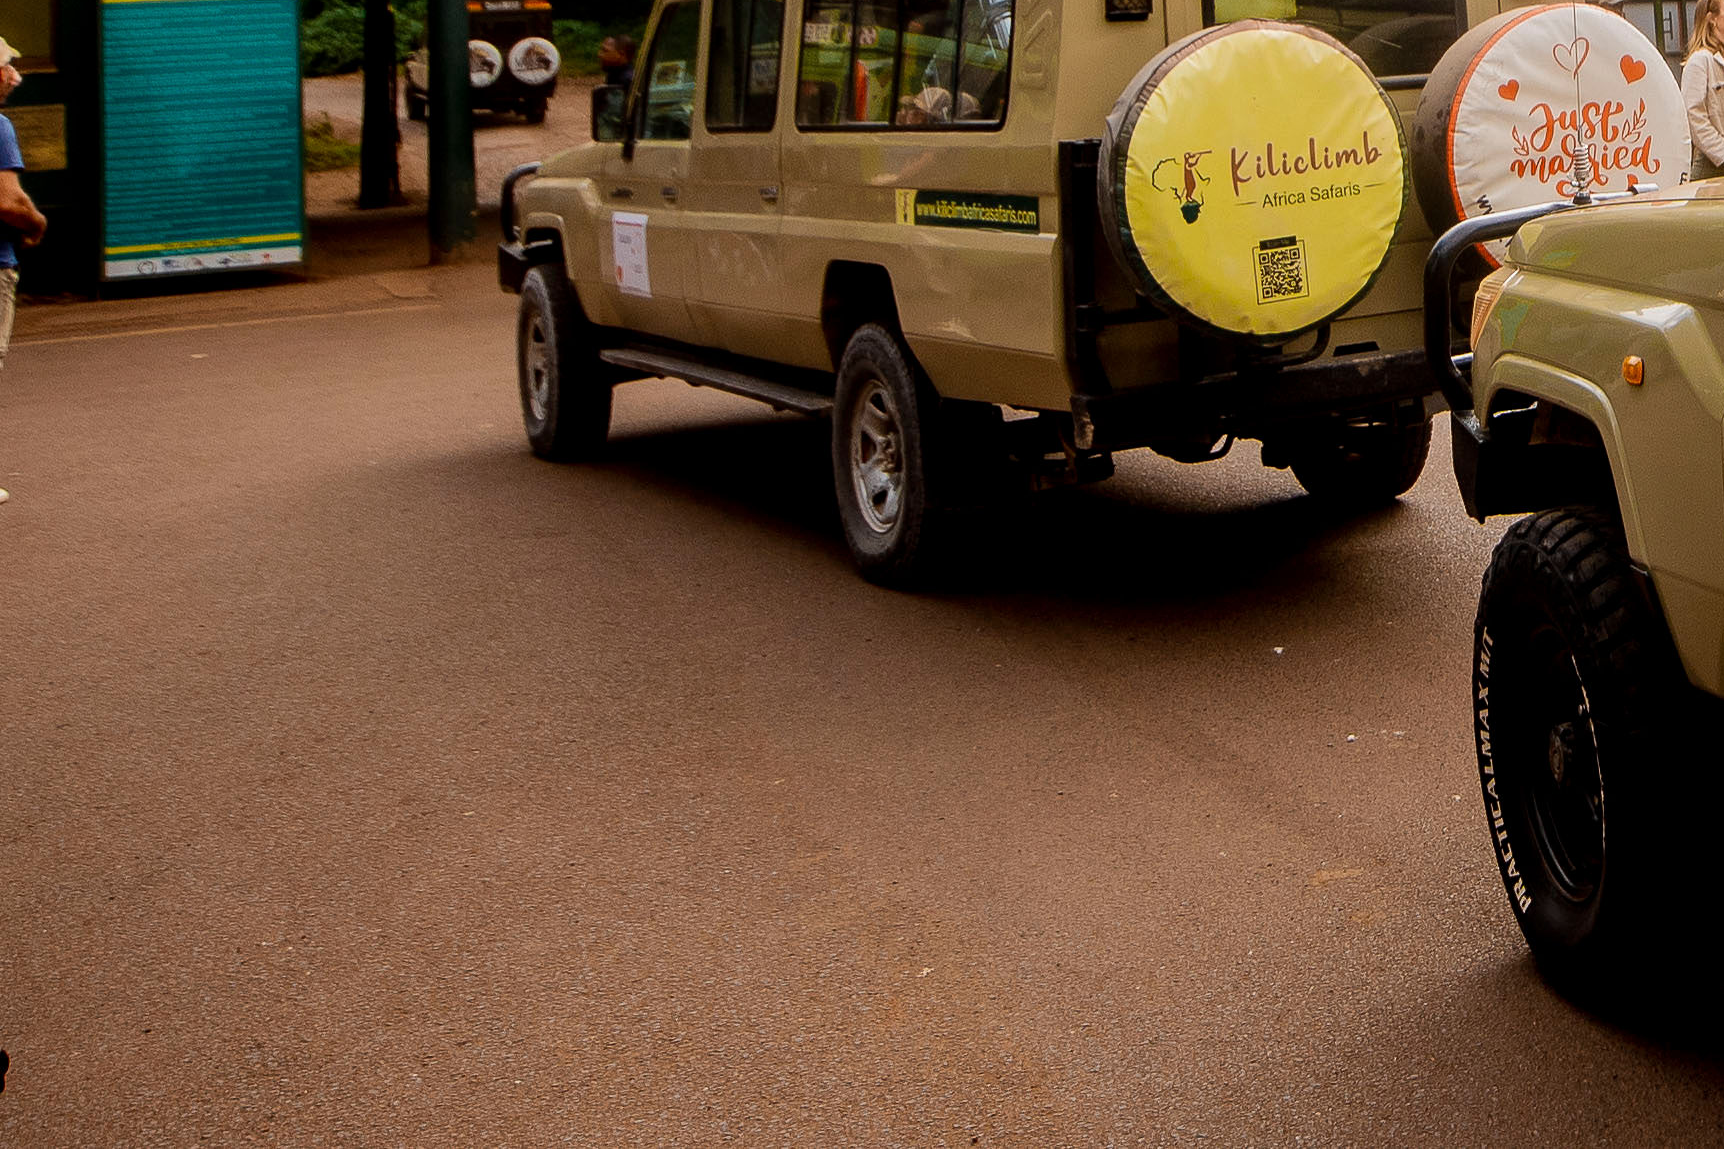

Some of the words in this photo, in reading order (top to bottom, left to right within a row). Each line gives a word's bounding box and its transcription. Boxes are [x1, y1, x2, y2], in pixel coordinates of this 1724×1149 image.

[1529, 100, 1624, 152] Just
[1230, 130, 1383, 197] Kiliclimb
[1262, 192, 1306, 209] Africa
[1310, 181, 1361, 202] Safaris
